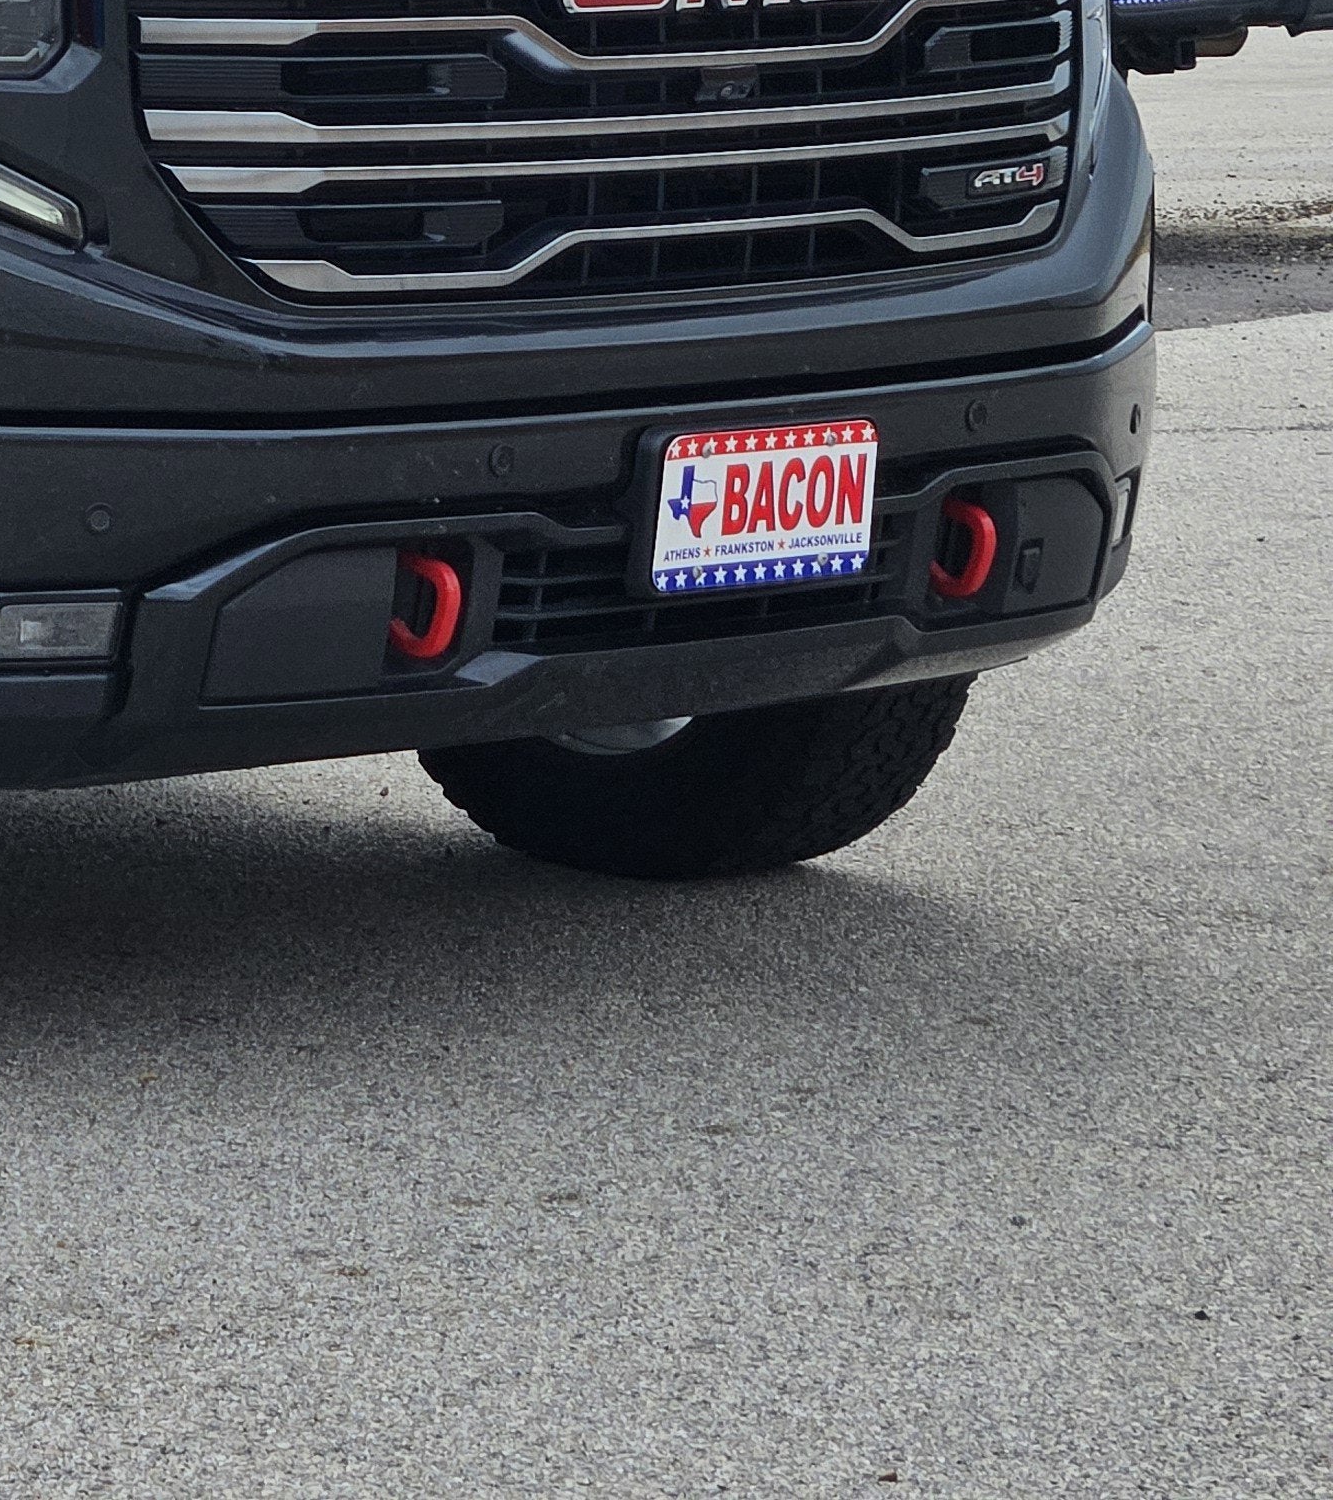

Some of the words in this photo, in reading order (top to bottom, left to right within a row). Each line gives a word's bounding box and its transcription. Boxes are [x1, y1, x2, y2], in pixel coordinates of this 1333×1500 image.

[973, 162, 1044, 189] AT4
[721, 453, 868, 536] BACON
[663, 547, 701, 562] ATHENS
[715, 540, 775, 557] FRANKSTON
[788, 531, 863, 550] JACKSONVILLE
